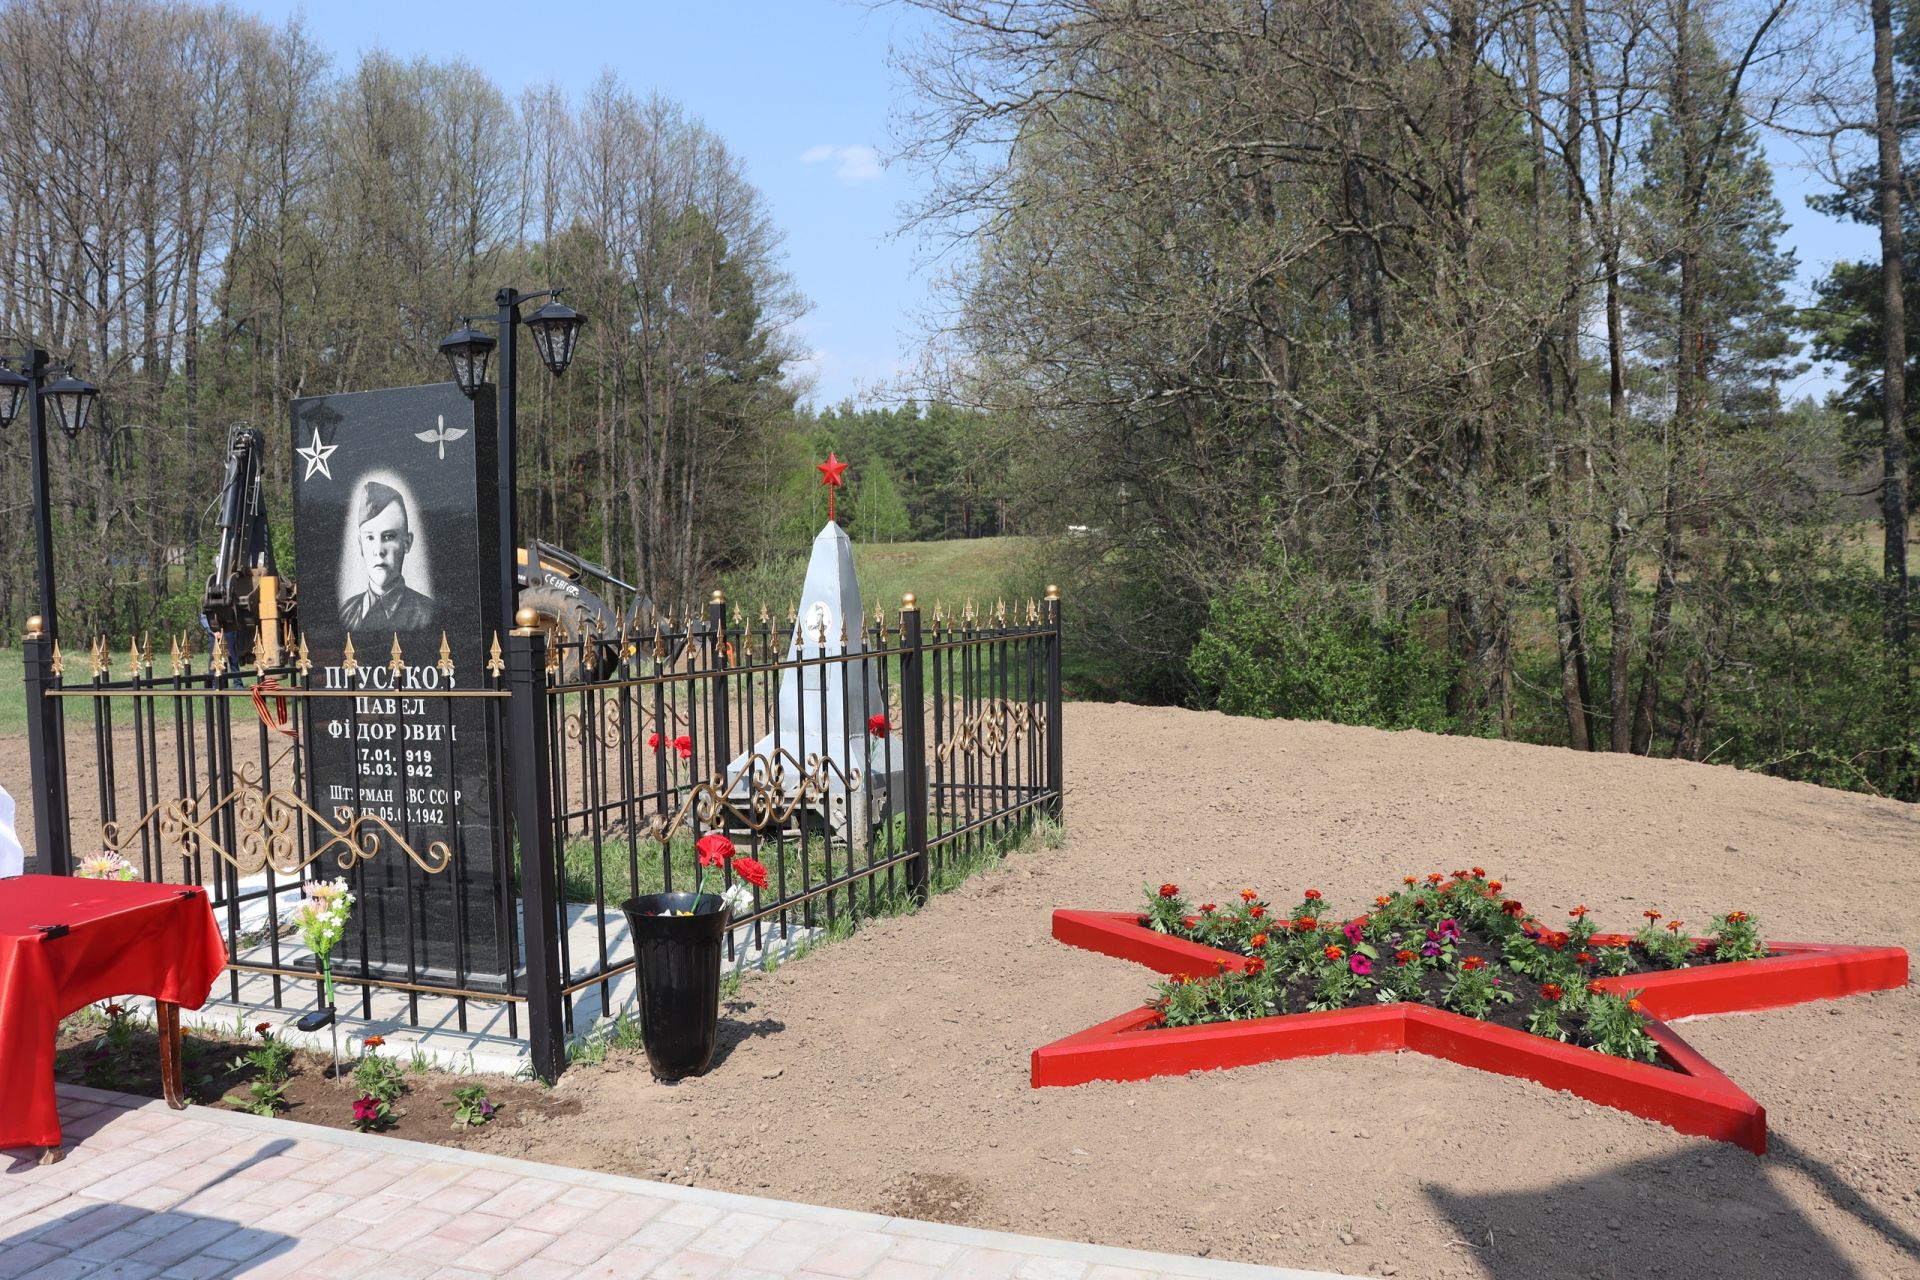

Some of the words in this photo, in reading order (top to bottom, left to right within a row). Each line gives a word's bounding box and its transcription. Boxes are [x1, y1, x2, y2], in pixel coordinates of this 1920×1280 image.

[355, 697, 426, 715] ПАВЕЛ
[357, 748, 432, 763] 7.01.919
[358, 763, 433, 778] 5.03.942
[405, 788, 426, 804] ВС
